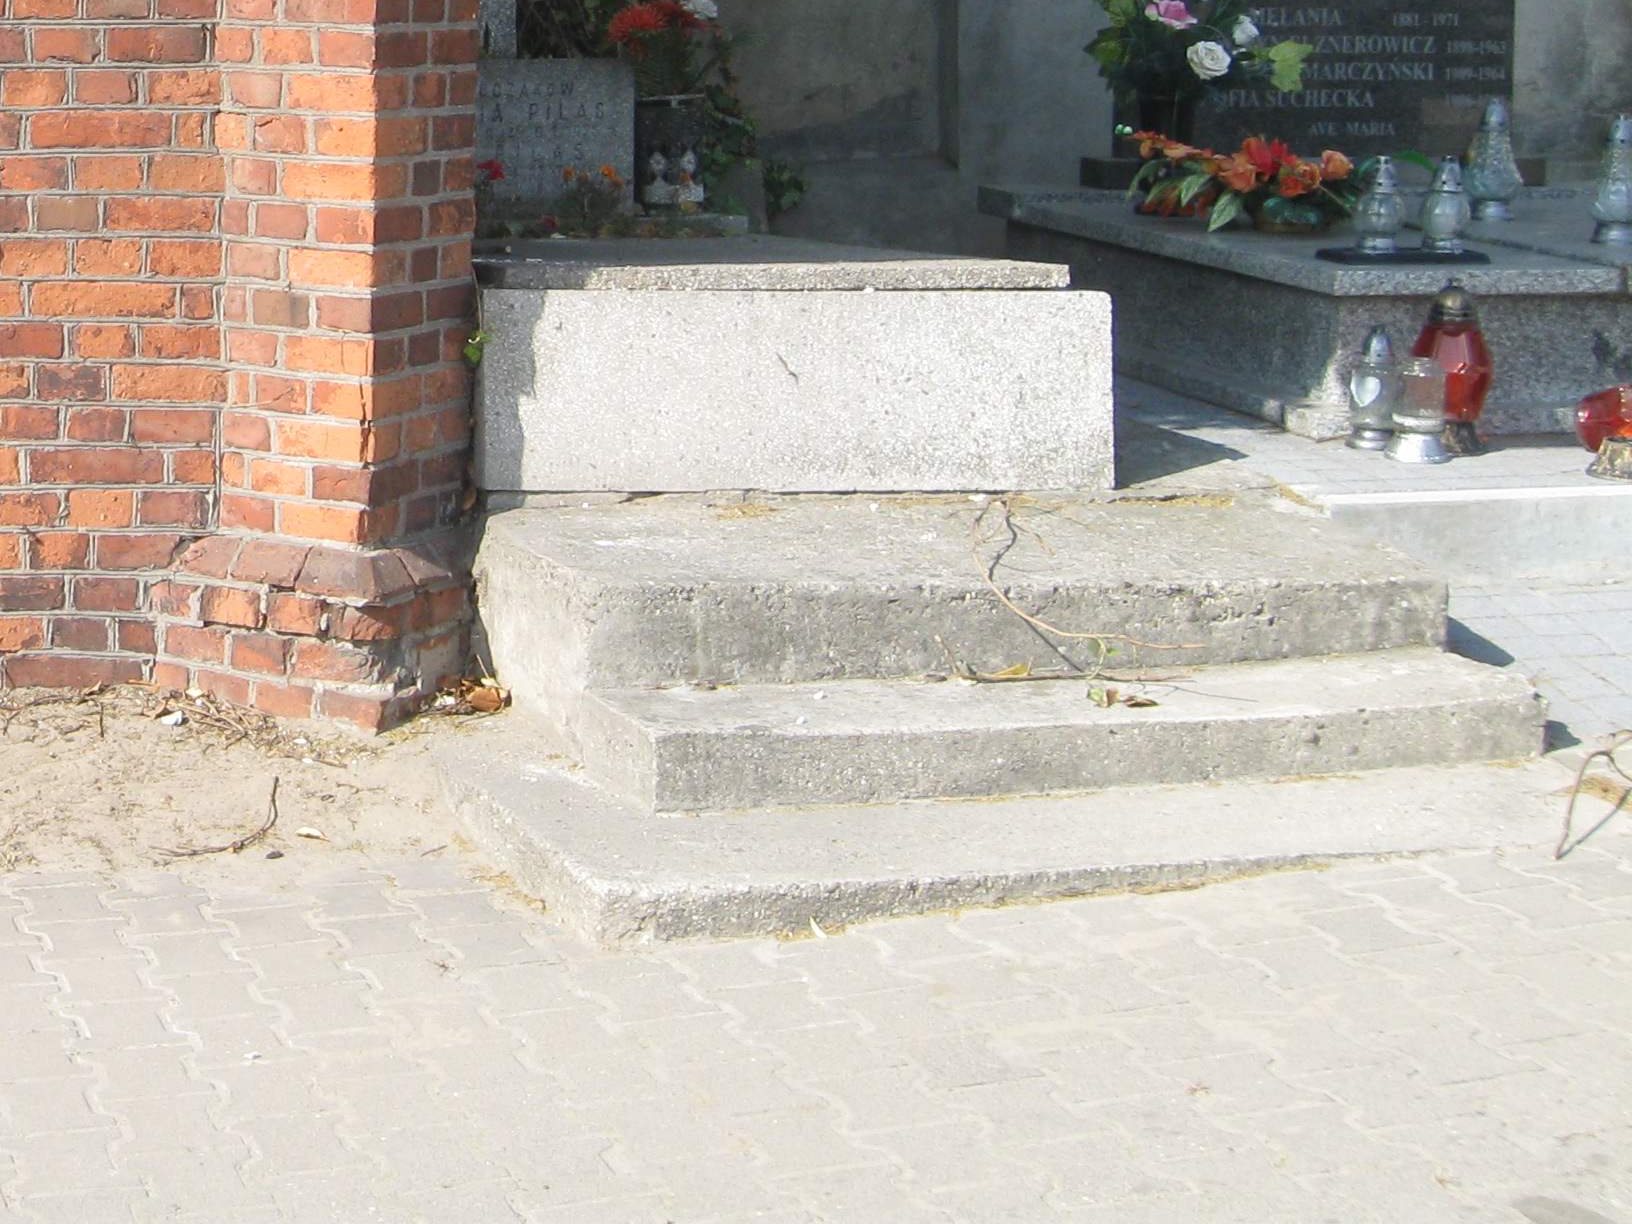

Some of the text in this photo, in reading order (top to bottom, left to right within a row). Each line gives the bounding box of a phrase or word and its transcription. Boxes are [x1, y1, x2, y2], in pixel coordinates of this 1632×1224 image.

[1248, 7, 1342, 27] MELANIA
[1265, 89, 1374, 108] SUCHECKA
[1306, 121, 1396, 136] AVE MARIA
